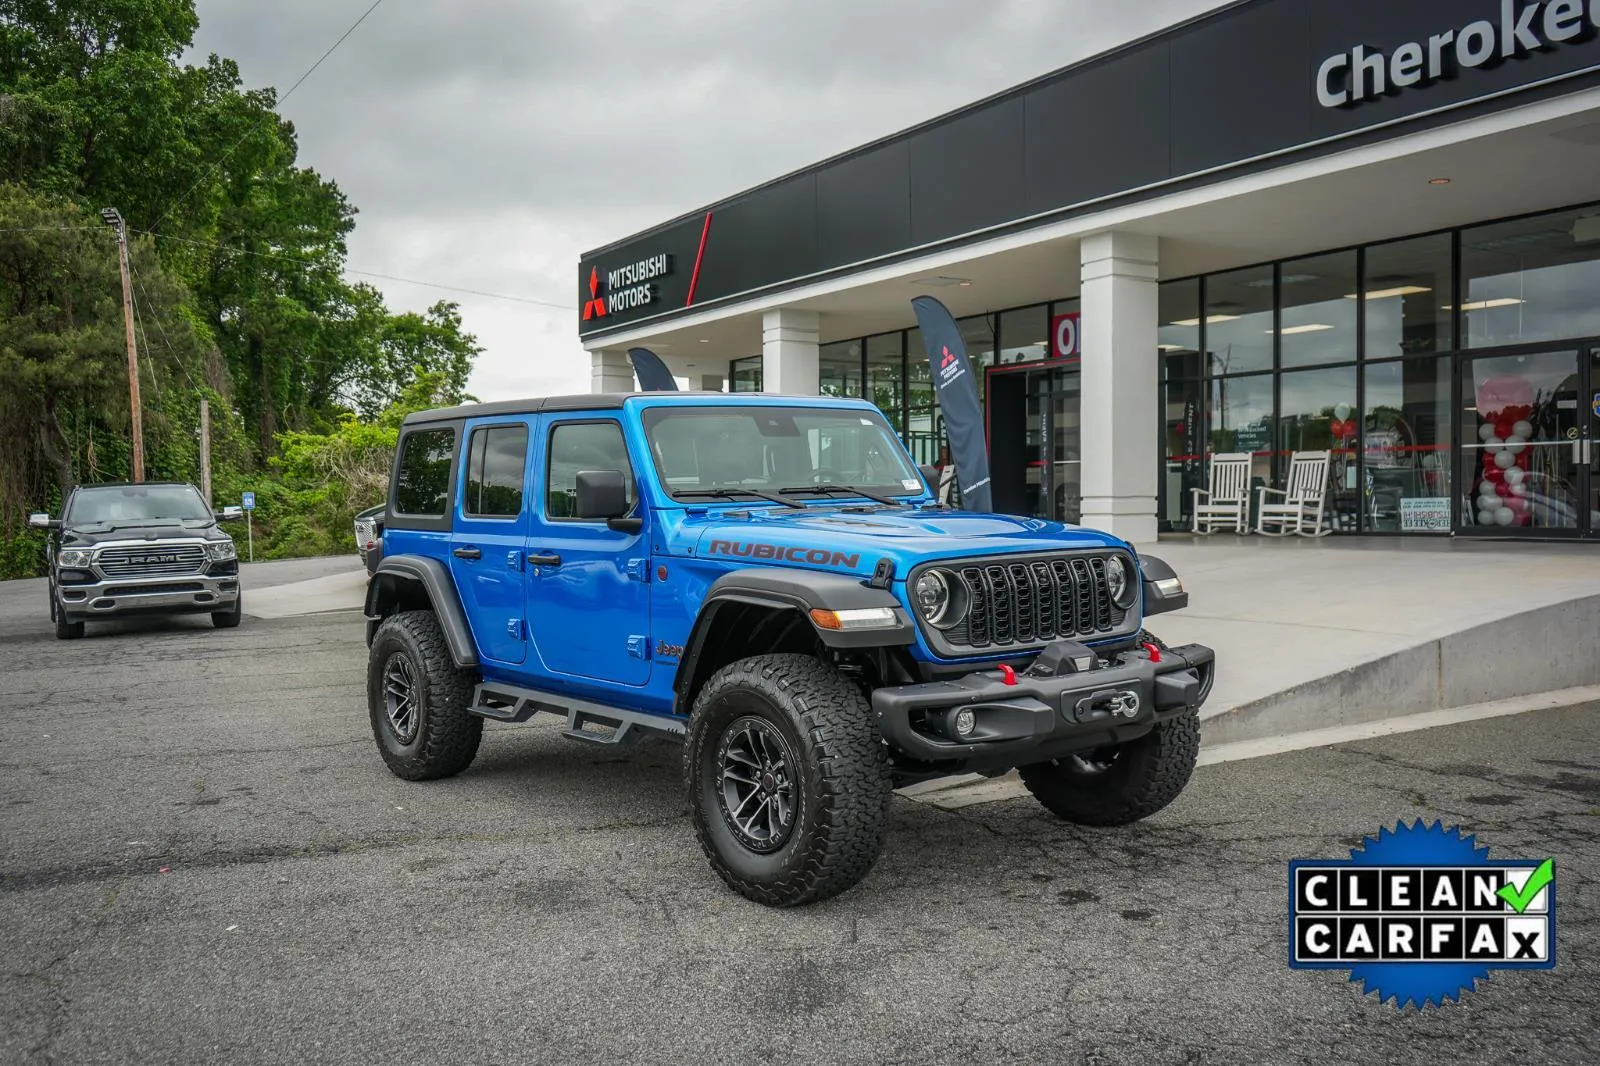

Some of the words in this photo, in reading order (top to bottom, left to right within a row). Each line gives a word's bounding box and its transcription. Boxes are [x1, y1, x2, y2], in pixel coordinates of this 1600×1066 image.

[1316, 0, 1600, 107] Cheroke
[608, 253, 667, 290] MITSUBISHI
[608, 283, 651, 313] MOTORS
[1057, 317, 1081, 355] O
[129, 554, 176, 564] RAM
[709, 539, 860, 569] RUBICON
[656, 639, 684, 661] Jeep
